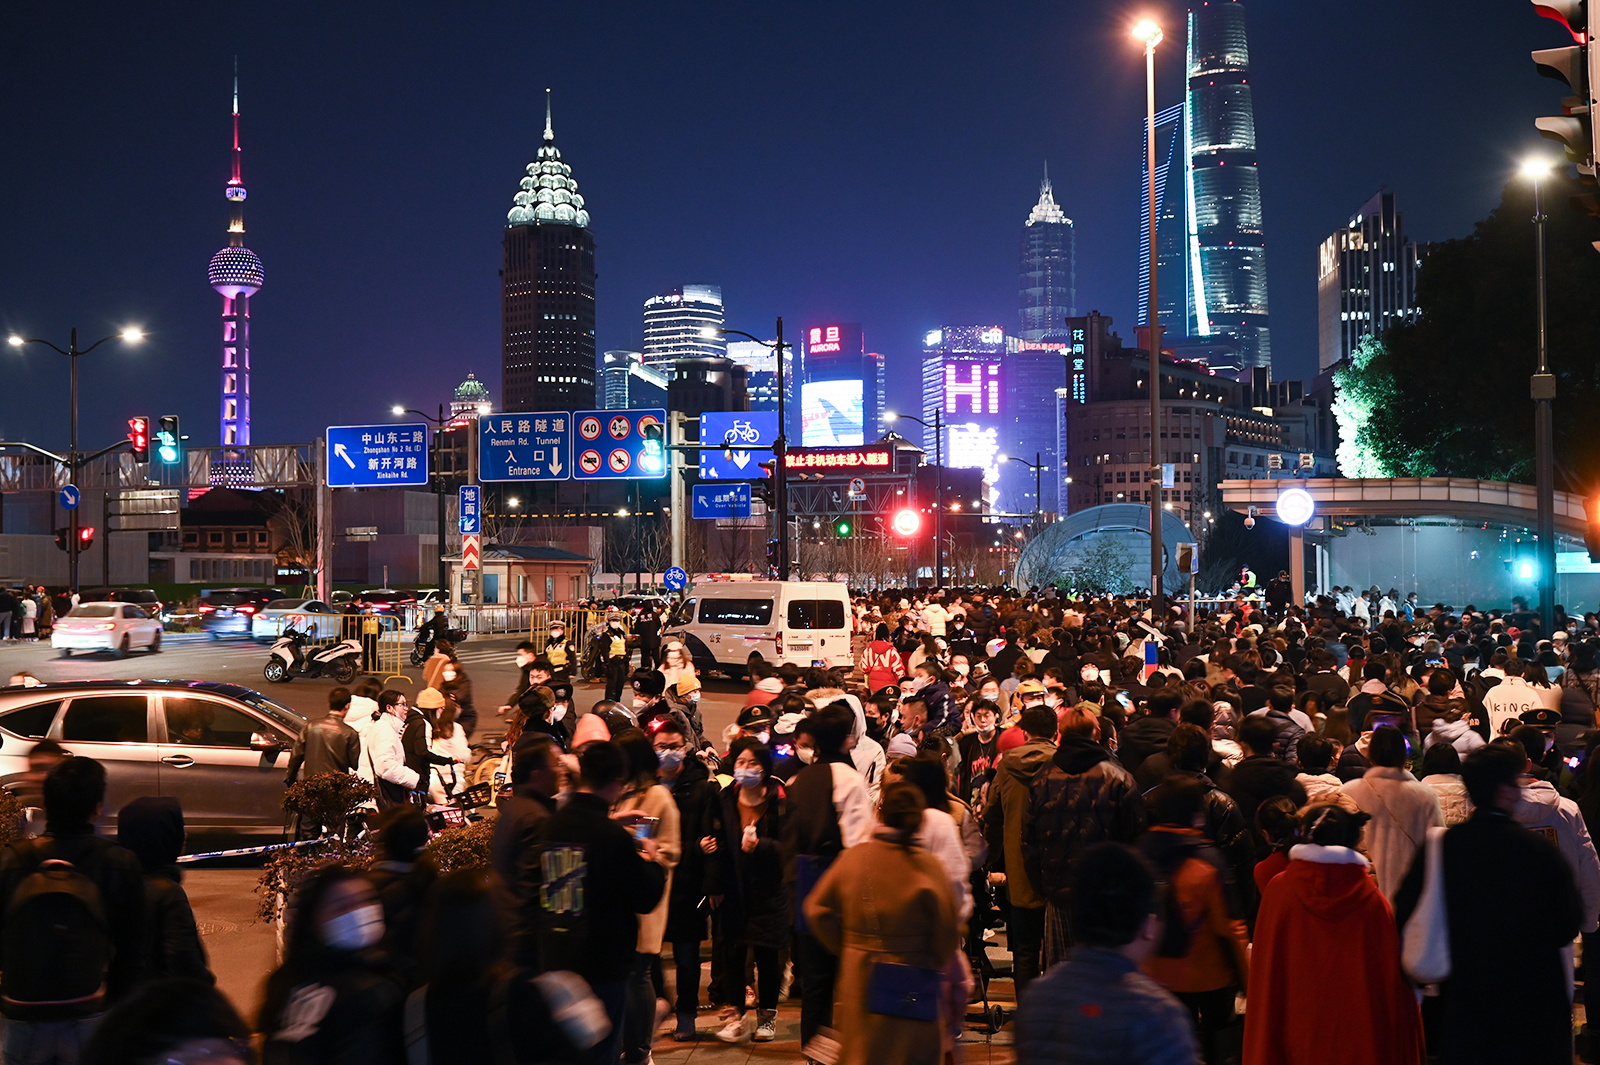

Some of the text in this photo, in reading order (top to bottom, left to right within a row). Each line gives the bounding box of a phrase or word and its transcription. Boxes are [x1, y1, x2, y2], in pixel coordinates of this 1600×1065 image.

[810, 343, 840, 353] AURORA
[1073, 329, 1085, 371] 花间堂
[946, 364, 999, 413] Hi
[484, 418, 565, 434] 人民路隧道
[584, 423, 597, 433] 40
[361, 431, 424, 445] 中山东二路
[491, 436, 561, 447] Renmin Rd. Tunnel
[363, 446, 390, 455] Zhongshan
[505, 449, 545, 463] 入口
[368, 457, 417, 470] 新开河路
[785, 452, 889, 467] 禁止非机动车进入隧道
[377, 471, 399, 479] Xinkaihe
[508, 465, 541, 476] Entrance
[464, 489, 476, 516] 地面
